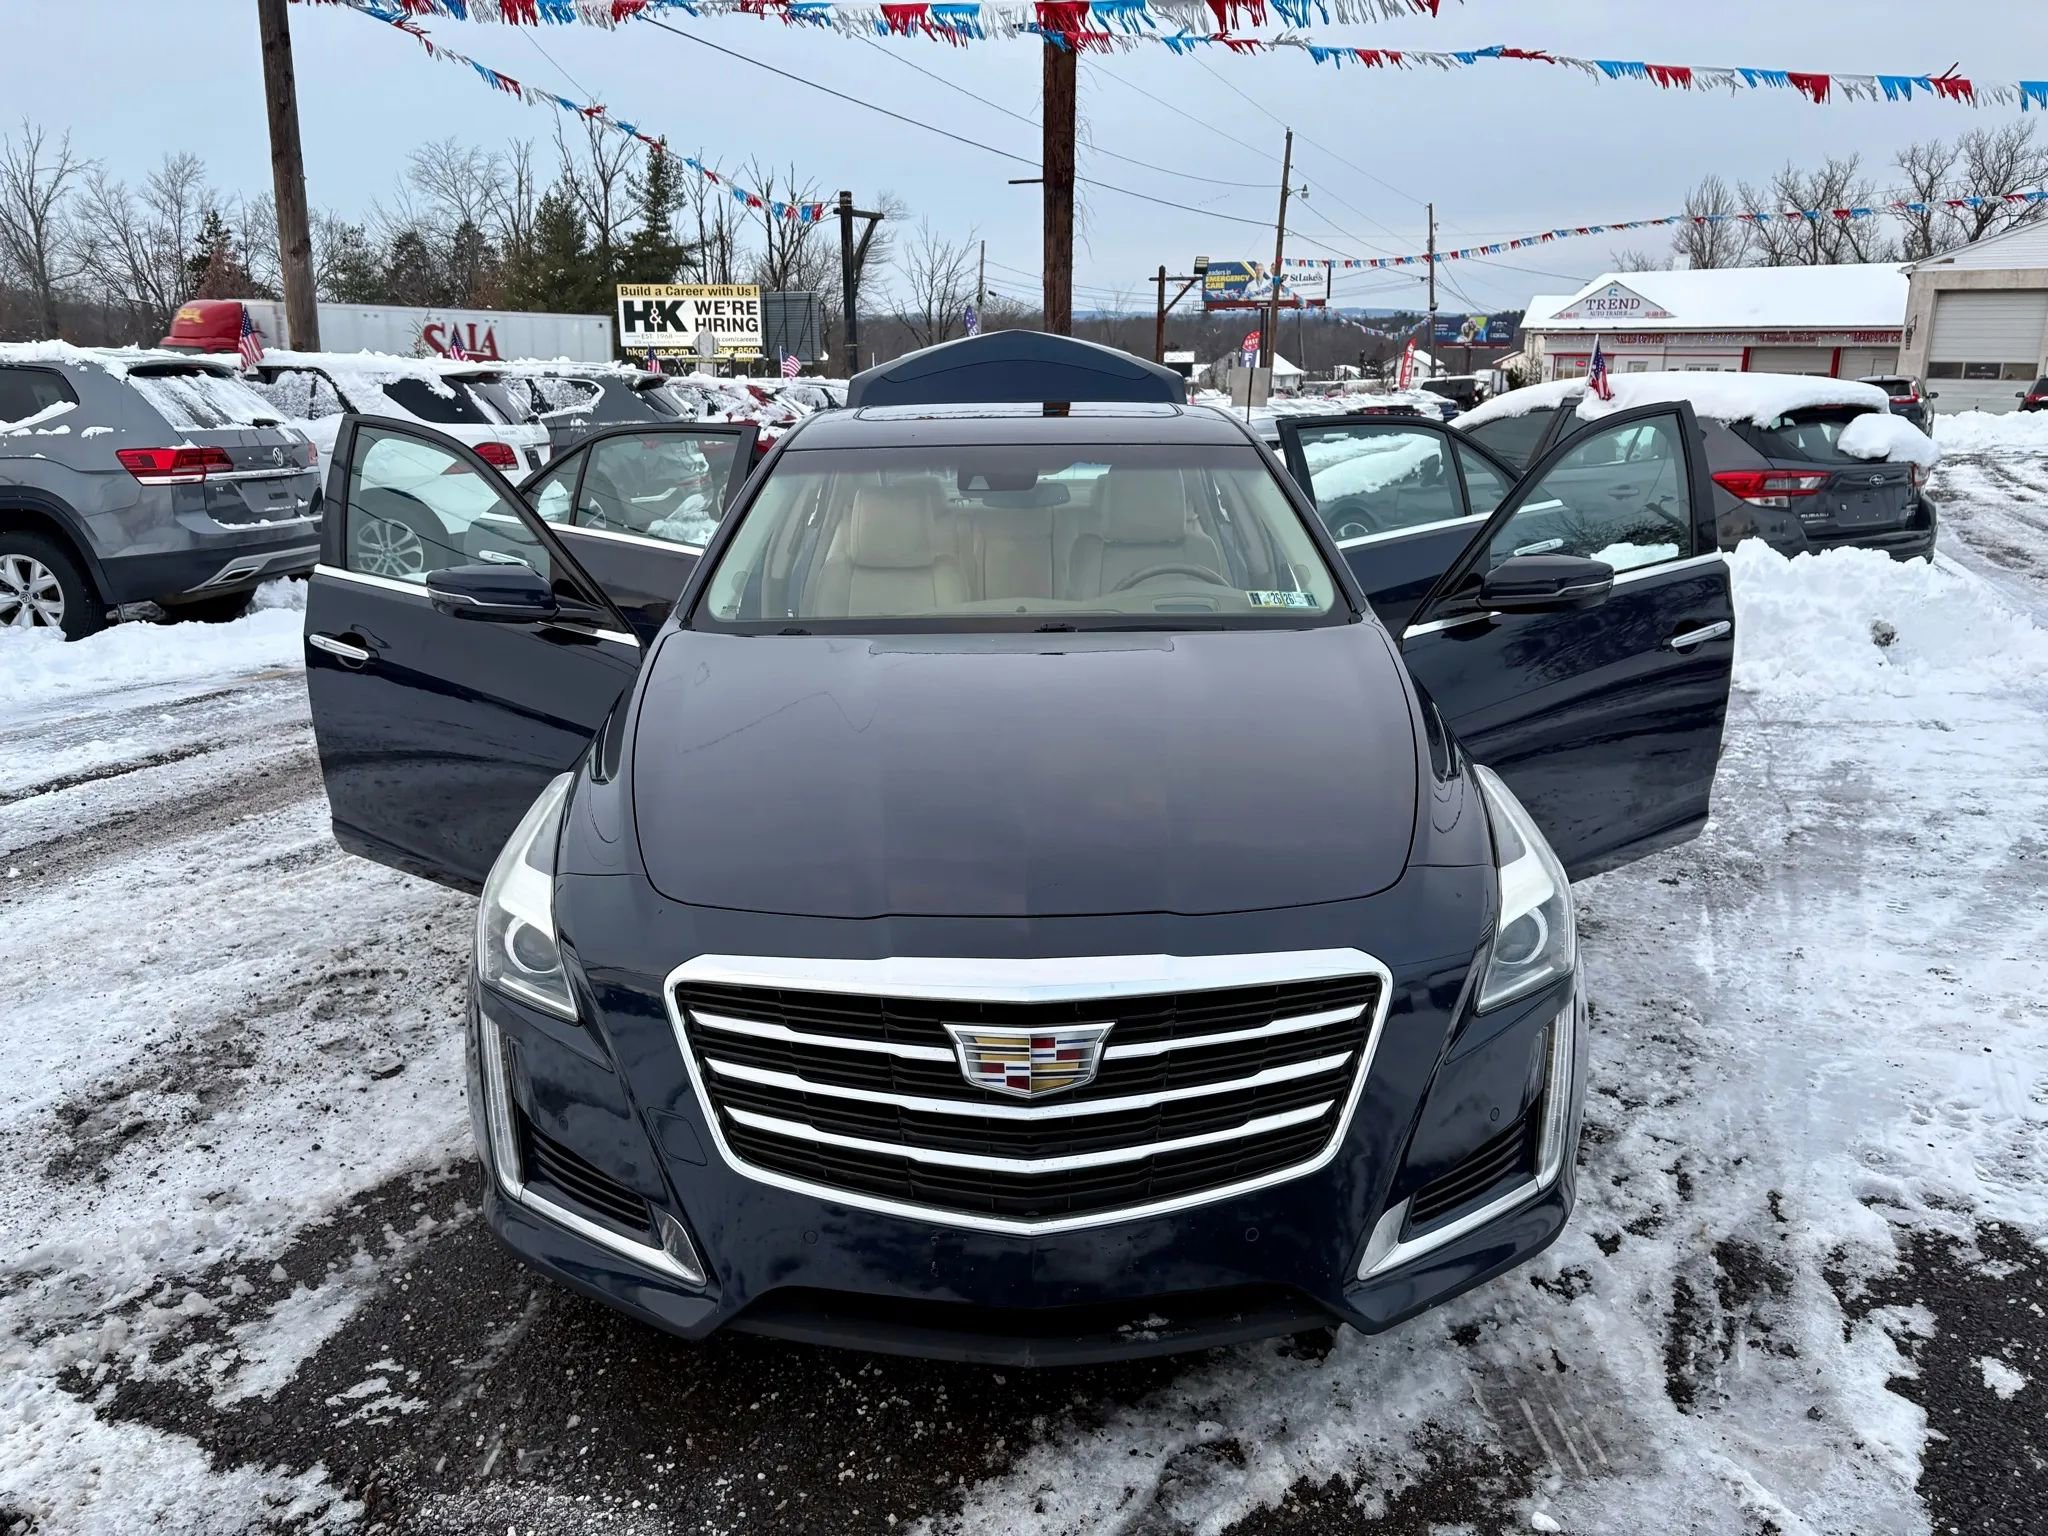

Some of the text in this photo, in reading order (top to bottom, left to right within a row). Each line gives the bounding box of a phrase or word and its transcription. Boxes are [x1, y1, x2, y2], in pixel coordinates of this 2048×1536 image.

[1206, 275, 1250, 283] EMERGENCY
[620, 286, 651, 296] Build
[655, 288, 662, 296] a
[665, 286, 704, 296] Career
[708, 286, 734, 296] with
[1206, 282, 1225, 290] CARE
[694, 300, 758, 315] WE'RE
[1586, 298, 1641, 311] TREND
[623, 300, 688, 332] H&K
[694, 317, 759, 332] HIRING
[423, 322, 502, 362] SIA
[626, 347, 689, 358] hkgrup.com
[1284, 592, 1295, 605] 26
